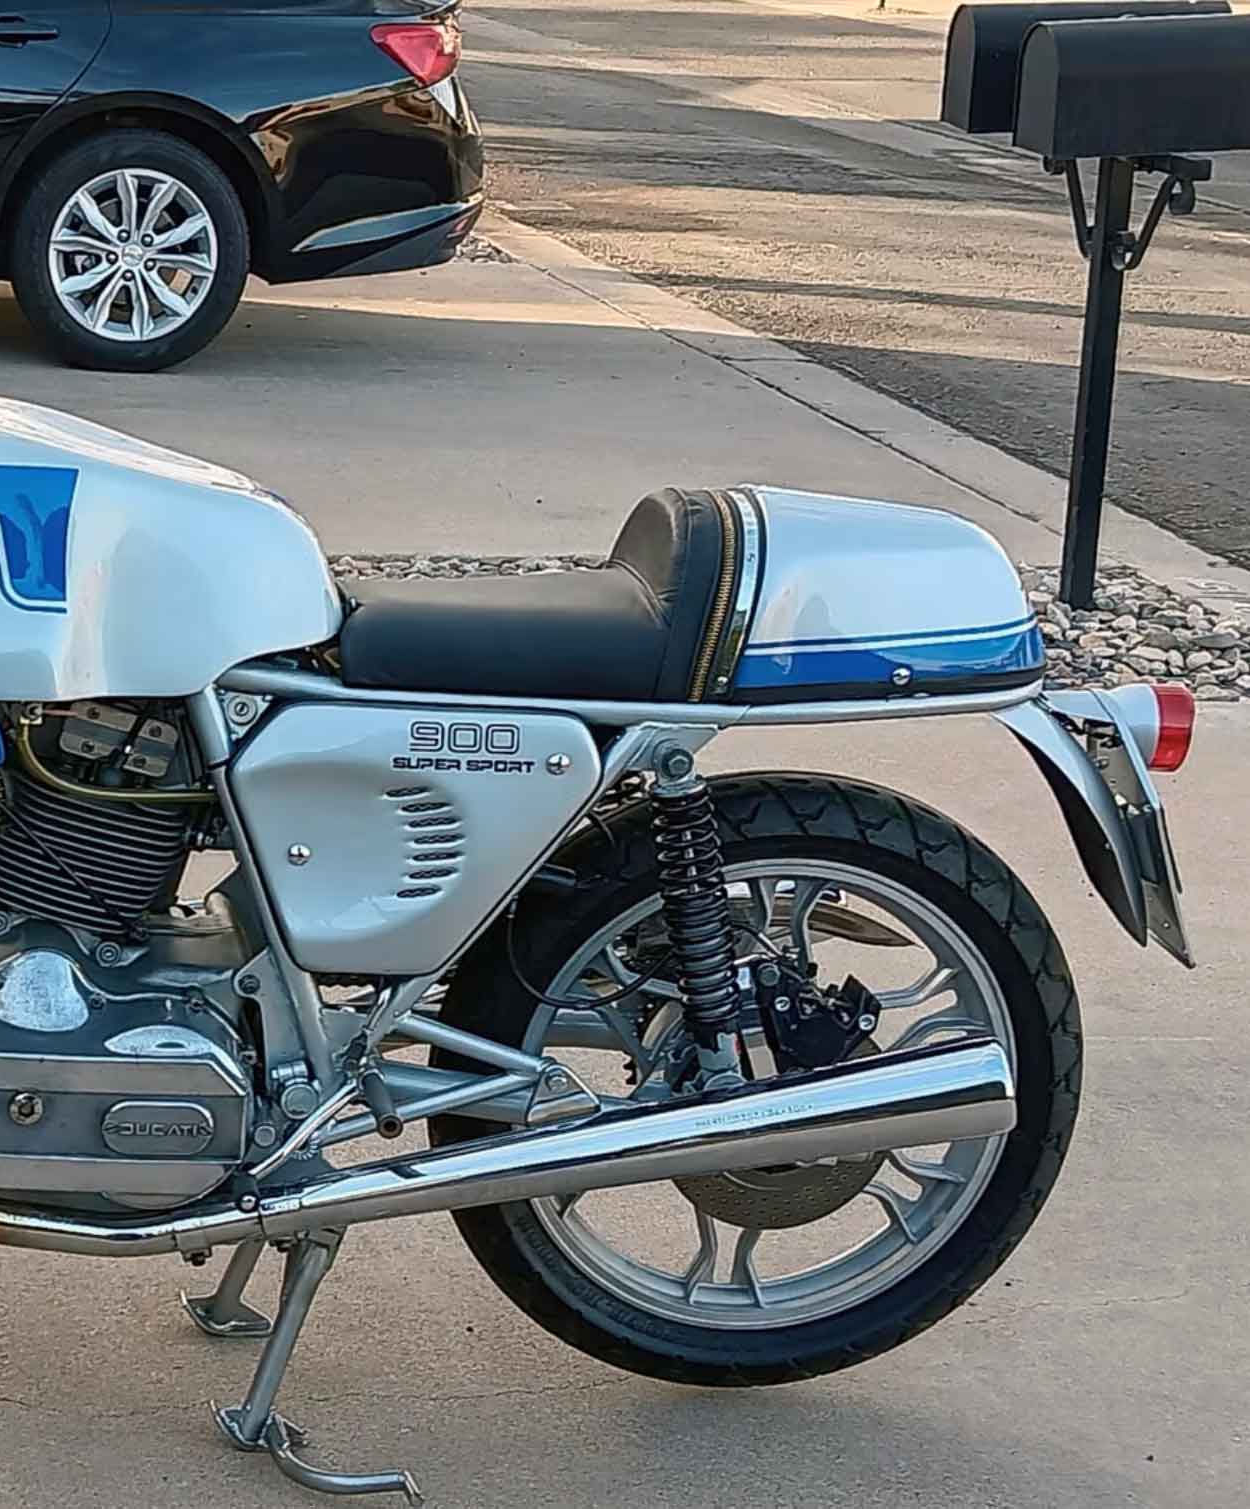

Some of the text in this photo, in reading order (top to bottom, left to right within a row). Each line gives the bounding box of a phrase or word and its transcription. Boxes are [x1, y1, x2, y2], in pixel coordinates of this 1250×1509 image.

[409, 721, 520, 755] 900
[392, 757, 535, 774] SUPER SPORT
[117, 1123, 198, 1136] DUCATI
